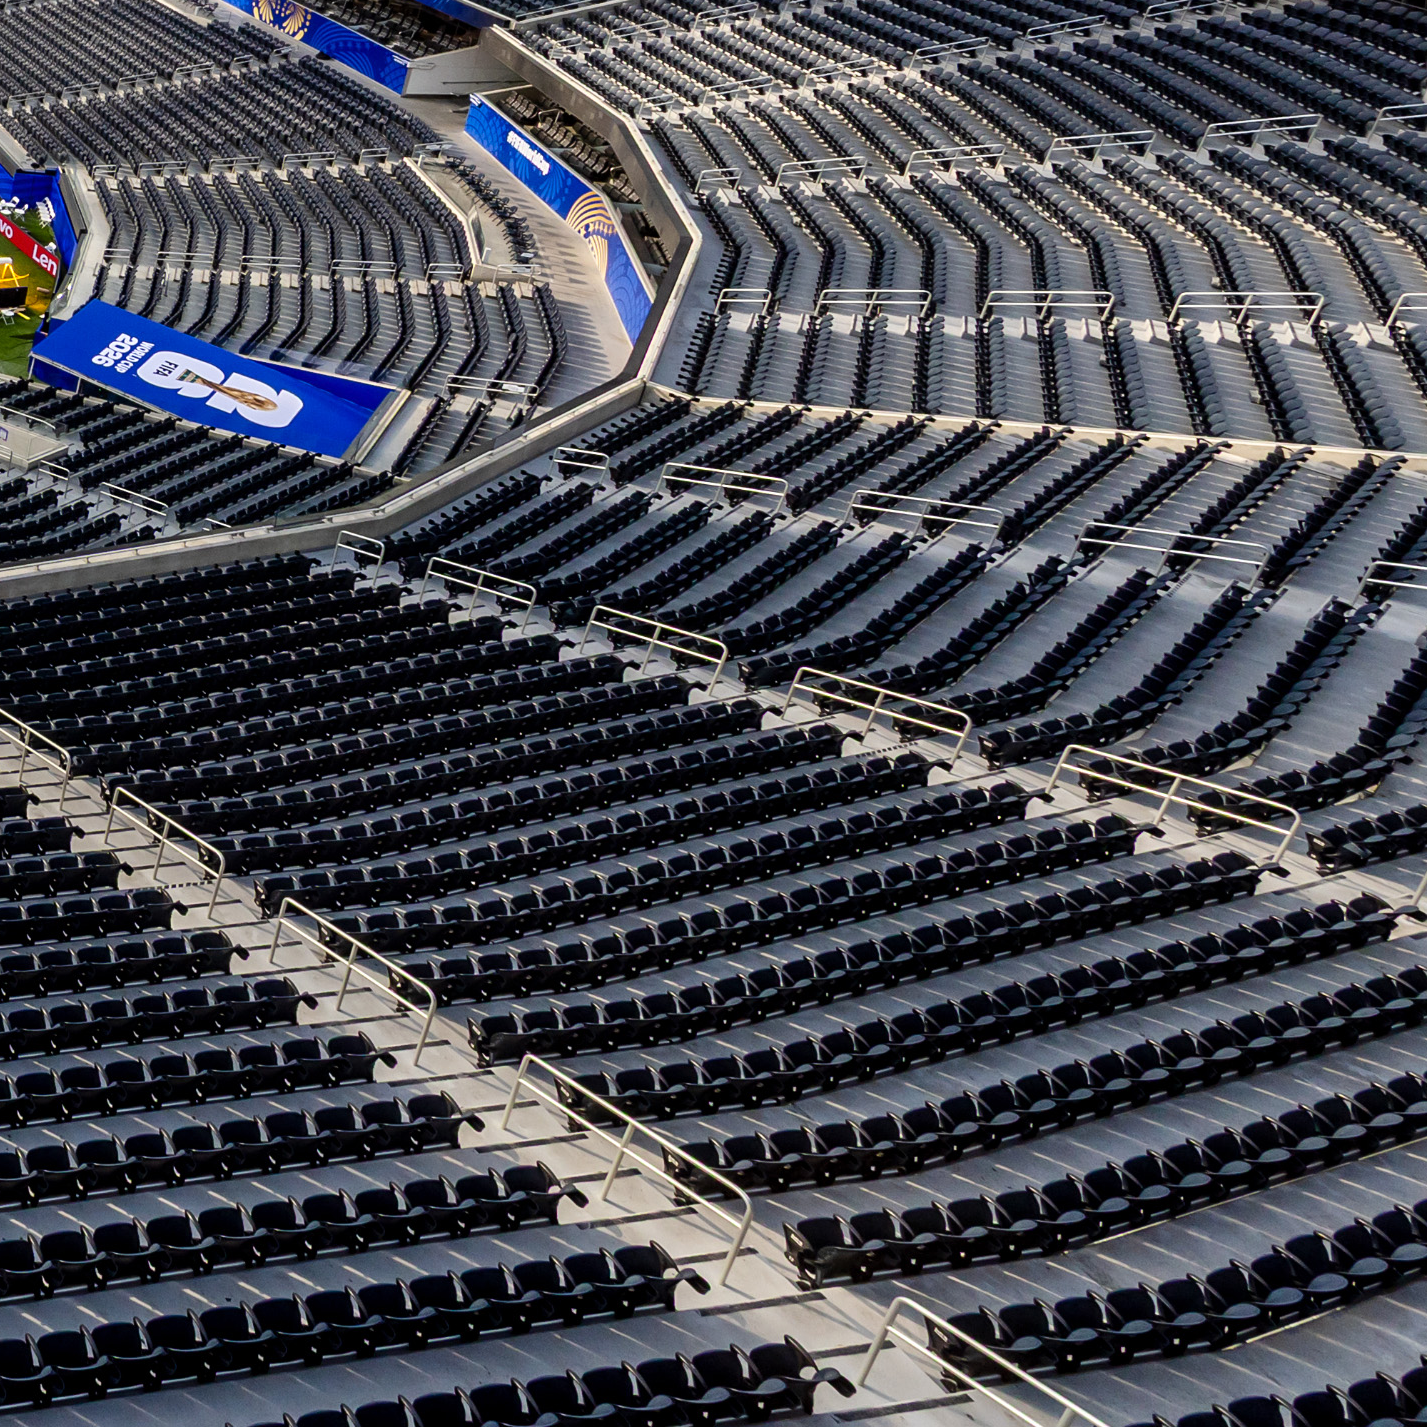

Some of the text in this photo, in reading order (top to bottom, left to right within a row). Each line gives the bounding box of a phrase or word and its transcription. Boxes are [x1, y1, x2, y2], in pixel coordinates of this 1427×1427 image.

[32, 243, 56, 277] Len
[91, 332, 138, 367] 2026
[114, 341, 155, 373] WORLD CUP
[153, 361, 178, 377] FIFA
